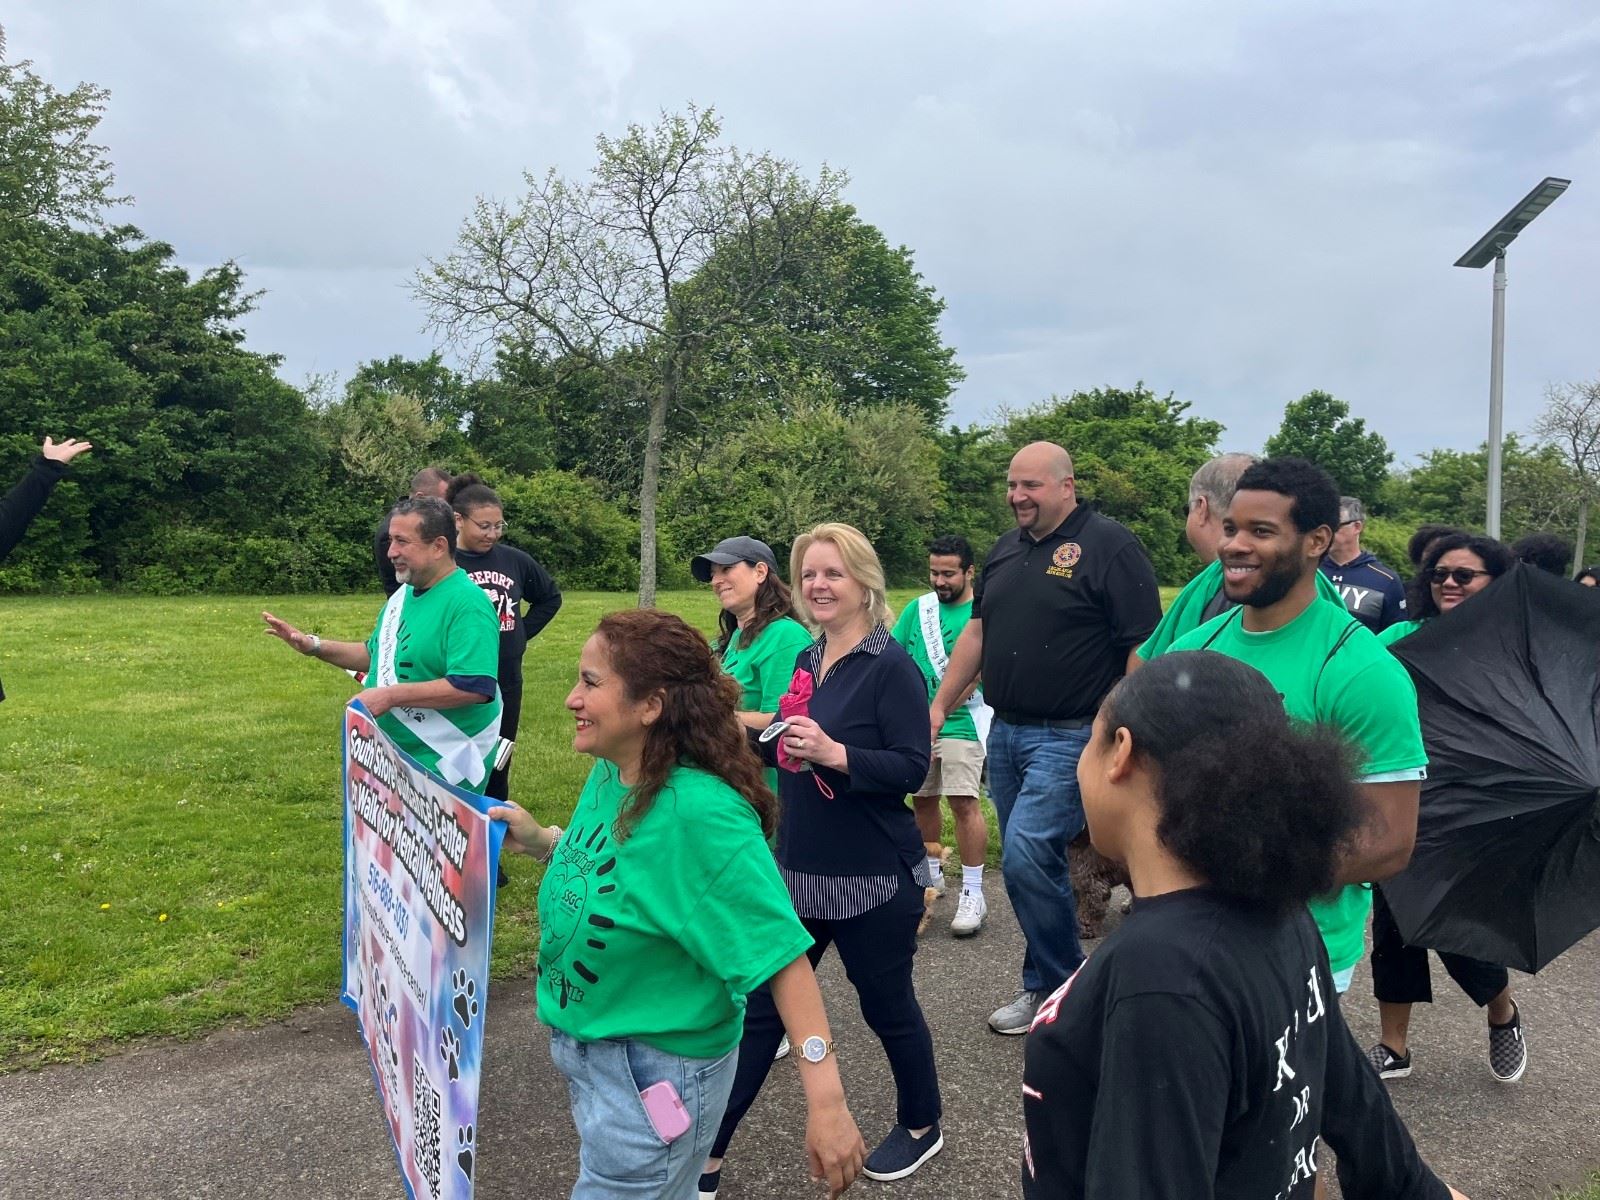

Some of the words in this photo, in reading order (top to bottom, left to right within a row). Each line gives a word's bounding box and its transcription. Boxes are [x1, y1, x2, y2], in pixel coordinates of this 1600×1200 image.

[467, 570, 514, 590] EEPORT
[349, 727, 374, 771] South
[373, 743, 396, 790] Shore
[432, 799, 468, 873] Center
[358, 782, 380, 830] Walk
[379, 801, 395, 843] for
[393, 816, 424, 881] Mental
[420, 847, 466, 944] Wellness
